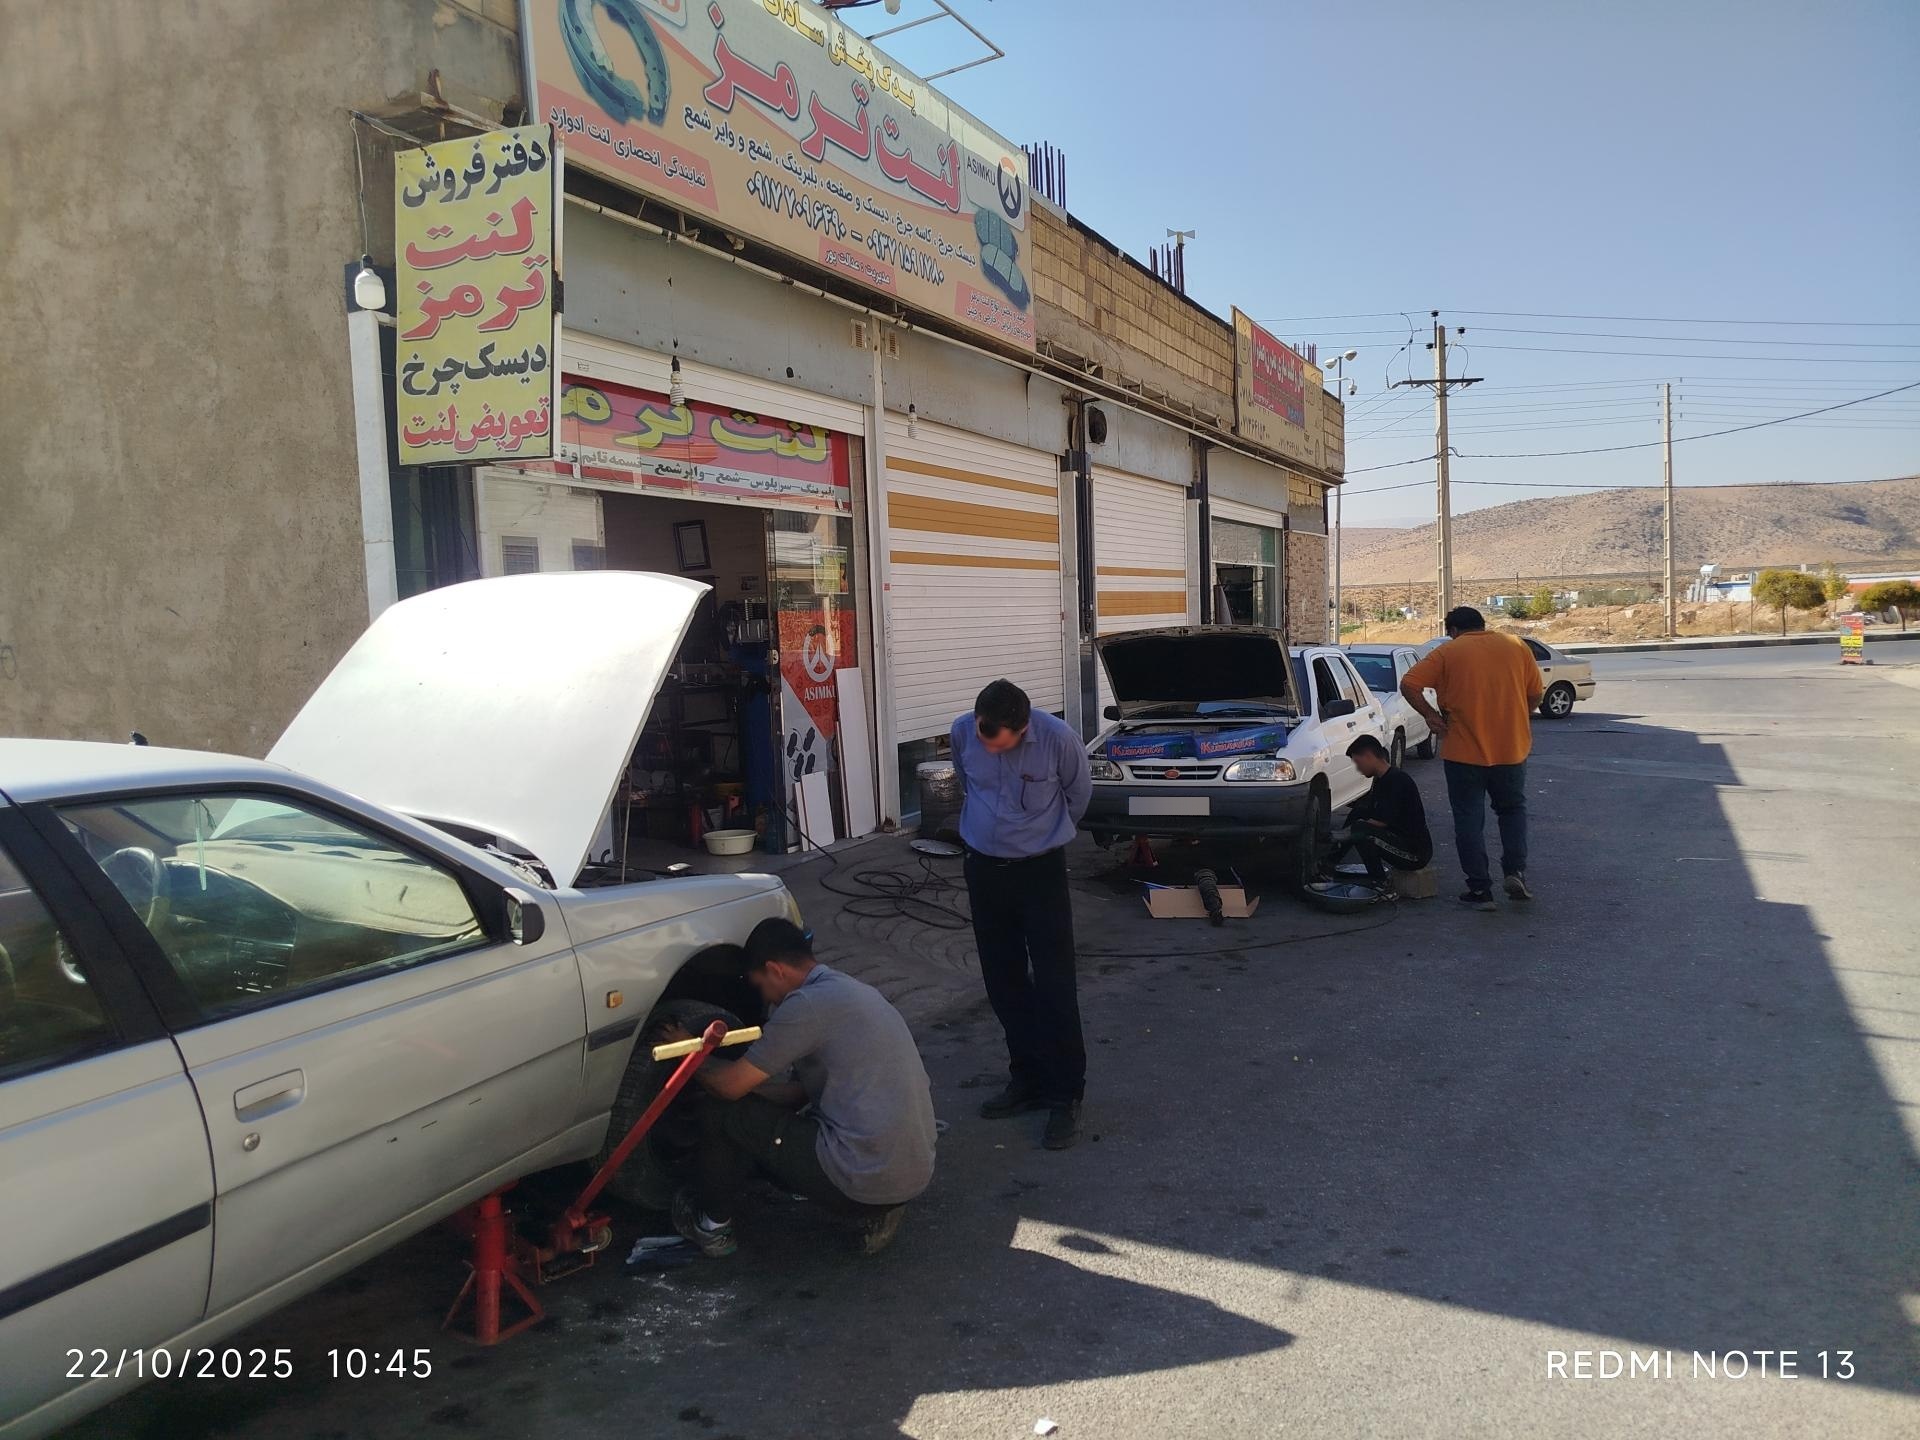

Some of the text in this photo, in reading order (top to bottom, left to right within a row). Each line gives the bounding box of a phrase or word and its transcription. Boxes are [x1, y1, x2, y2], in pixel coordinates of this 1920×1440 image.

[684, 105, 712, 129] شمع
[703, 1, 961, 213] لنت ترمز
[876, 66, 917, 117] یدک
[550, 107, 707, 188] نمایندگی انحصاری لنت ادوارد
[714, 121, 735, 148] وایر
[738, 136, 745, 152] و
[748, 138, 772, 161] شمع
[402, 133, 546, 208] دفتر فروش
[966, 155, 996, 186] ASIMKU
[405, 196, 537, 270] لنت
[862, 197, 890, 223] دیسک
[915, 226, 932, 243] کاسه
[954, 246, 976, 269] دیسک
[401, 254, 549, 341] ترمز
[402, 342, 547, 396] دیسک چرخ
[402, 395, 550, 453] تعویض لنت
[710, 410, 830, 463] لنت
